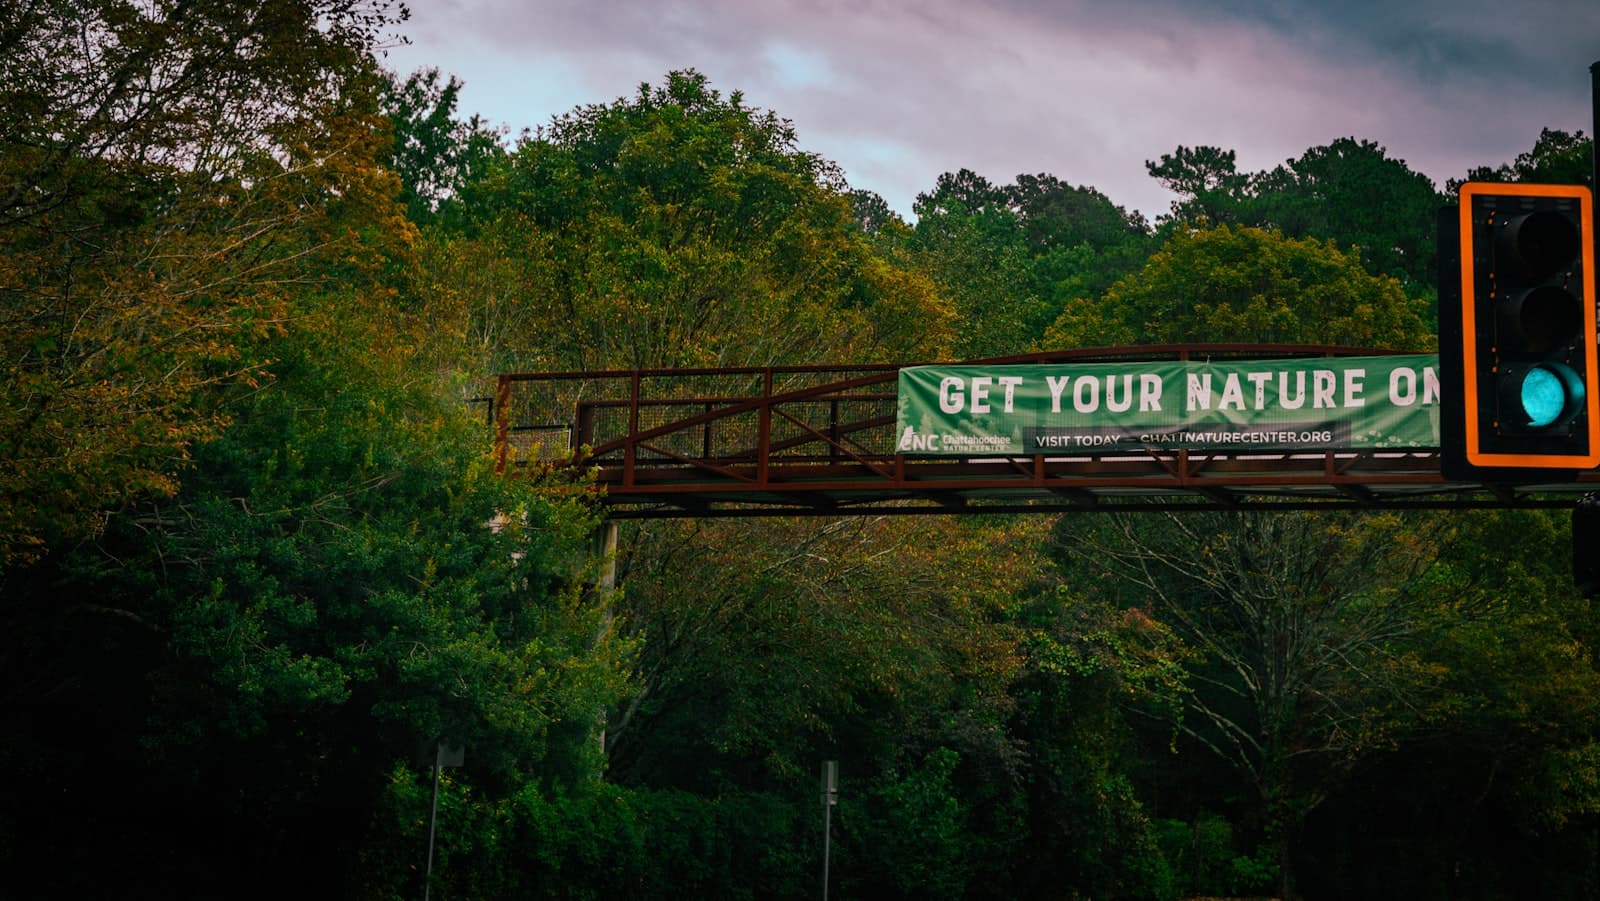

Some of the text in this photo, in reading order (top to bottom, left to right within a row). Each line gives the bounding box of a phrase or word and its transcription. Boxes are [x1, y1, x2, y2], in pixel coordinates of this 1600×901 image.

[938, 376, 1023, 414] GET
[1045, 373, 1164, 413] YOUR
[1186, 368, 1367, 412] NATURE
[942, 434, 1012, 445] Chattahoochee
[1036, 430, 1332, 447] VISIT TODAY CHATTNATURECENTER.ORG
